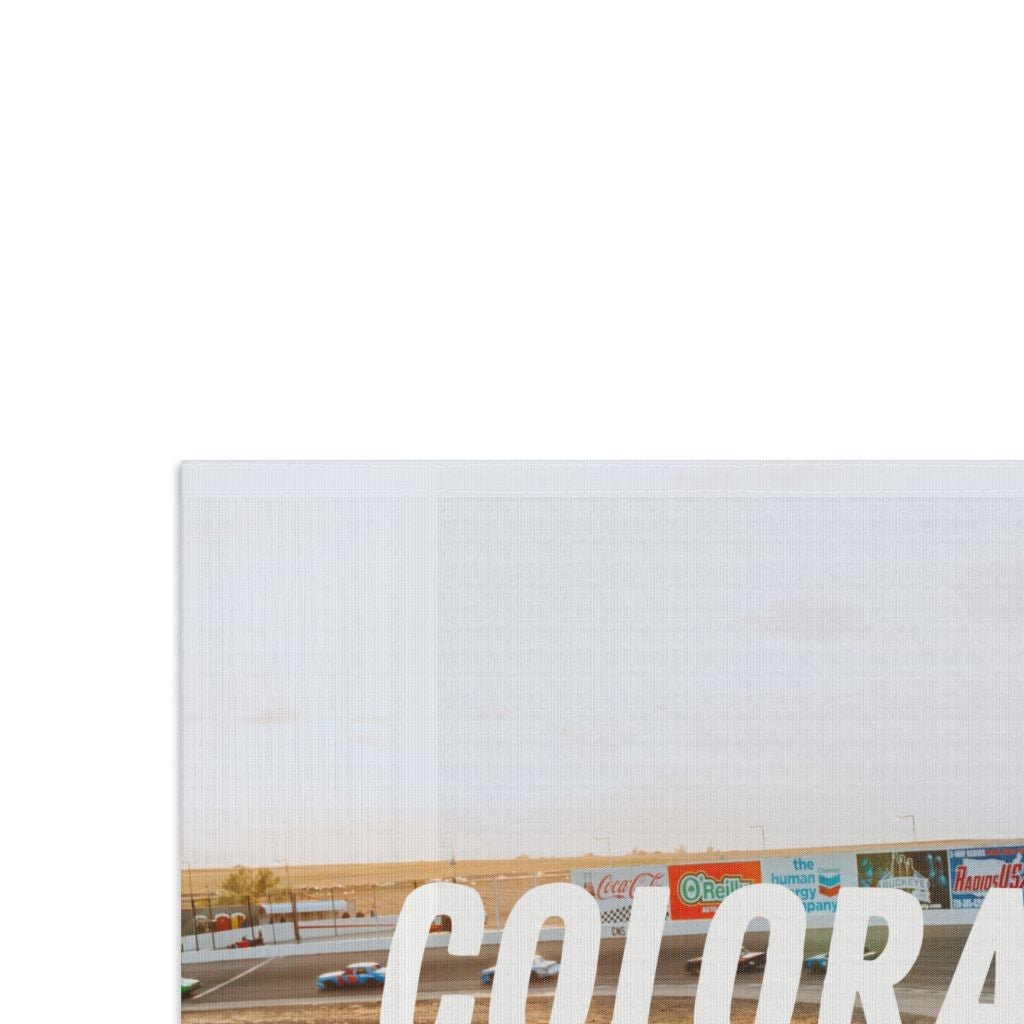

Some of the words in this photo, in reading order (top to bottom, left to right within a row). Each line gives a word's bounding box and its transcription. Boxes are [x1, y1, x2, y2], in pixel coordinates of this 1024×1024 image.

[792, 858, 814, 871] the
[771, 873, 816, 885] human
[612, 926, 625, 936] CNS
